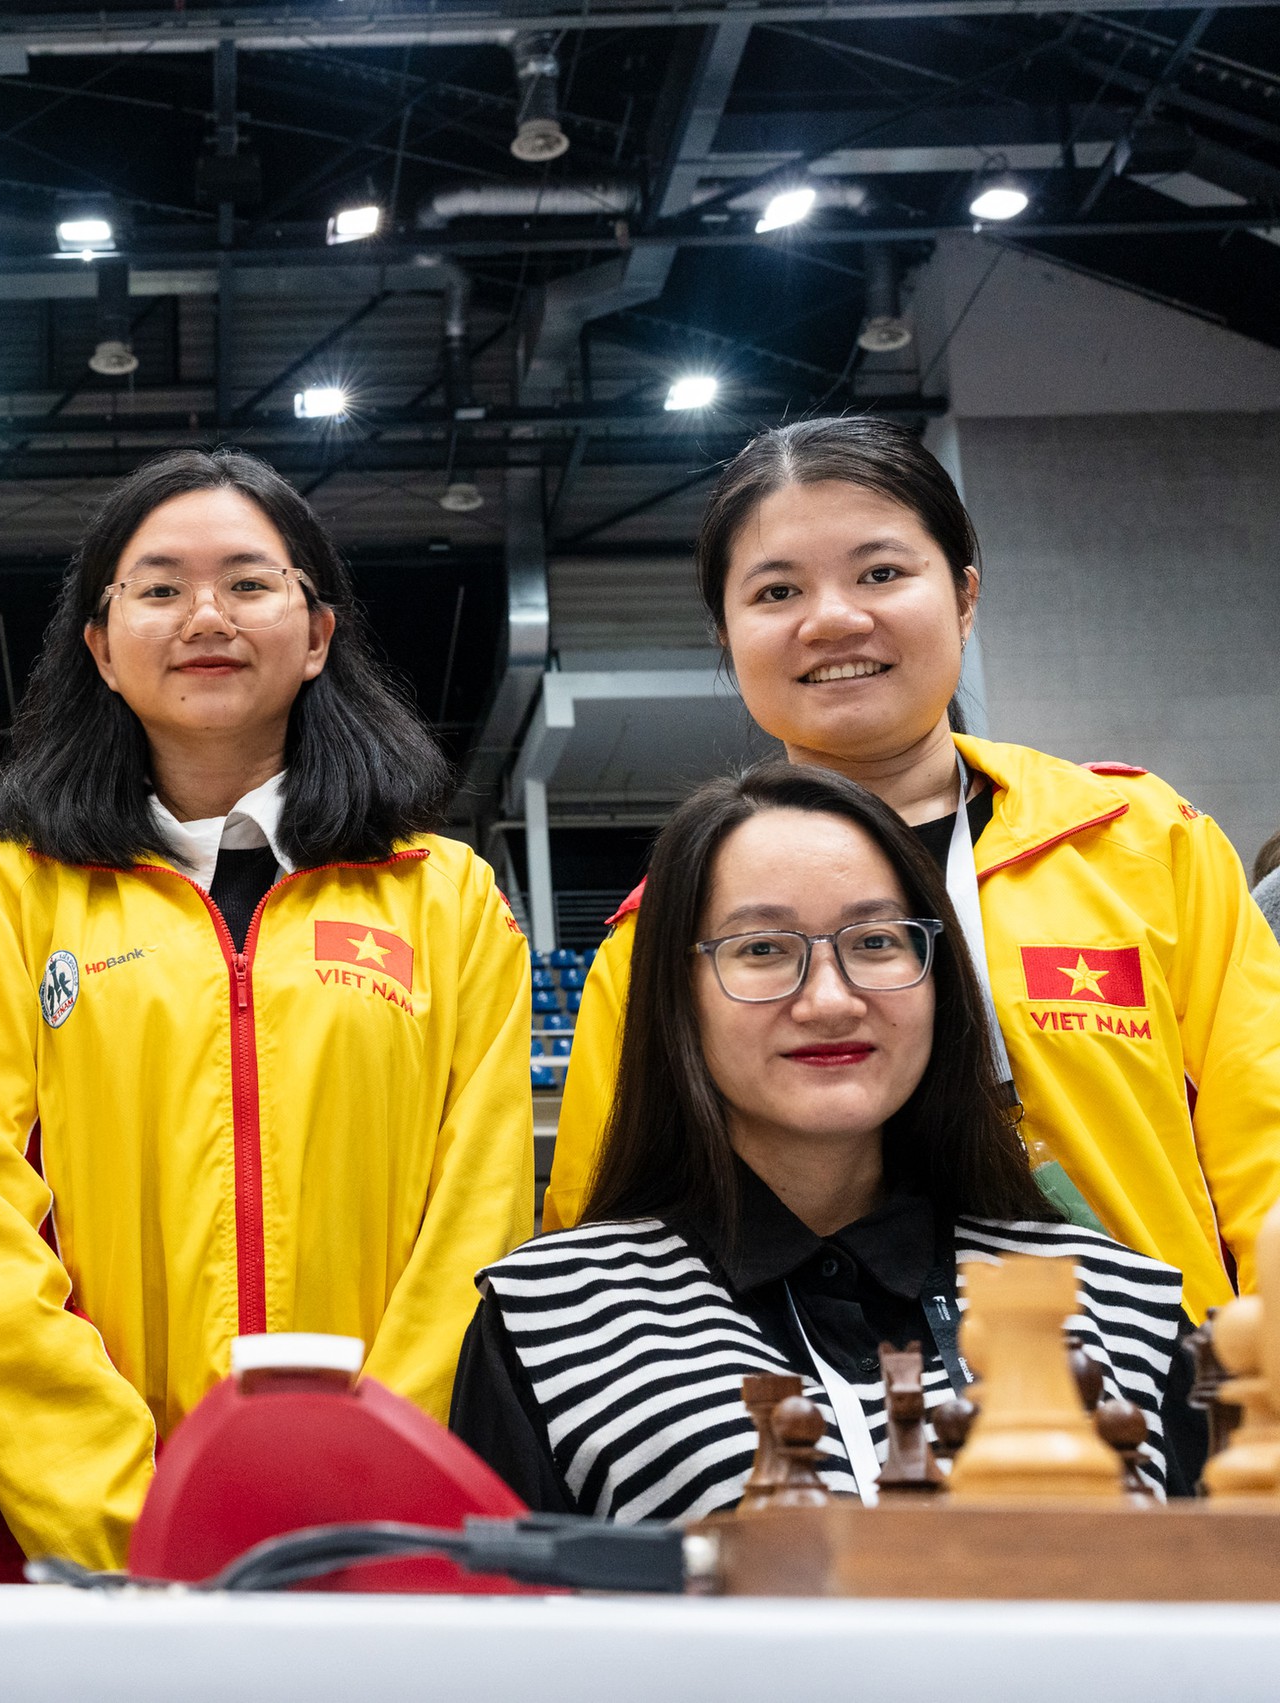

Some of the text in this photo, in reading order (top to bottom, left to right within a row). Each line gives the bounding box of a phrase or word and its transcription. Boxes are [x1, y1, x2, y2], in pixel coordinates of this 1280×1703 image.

[85, 948, 145, 975] HDBank
[315, 968, 415, 1017] VIET NAM
[1030, 1011, 1152, 1040] VIET NAM
